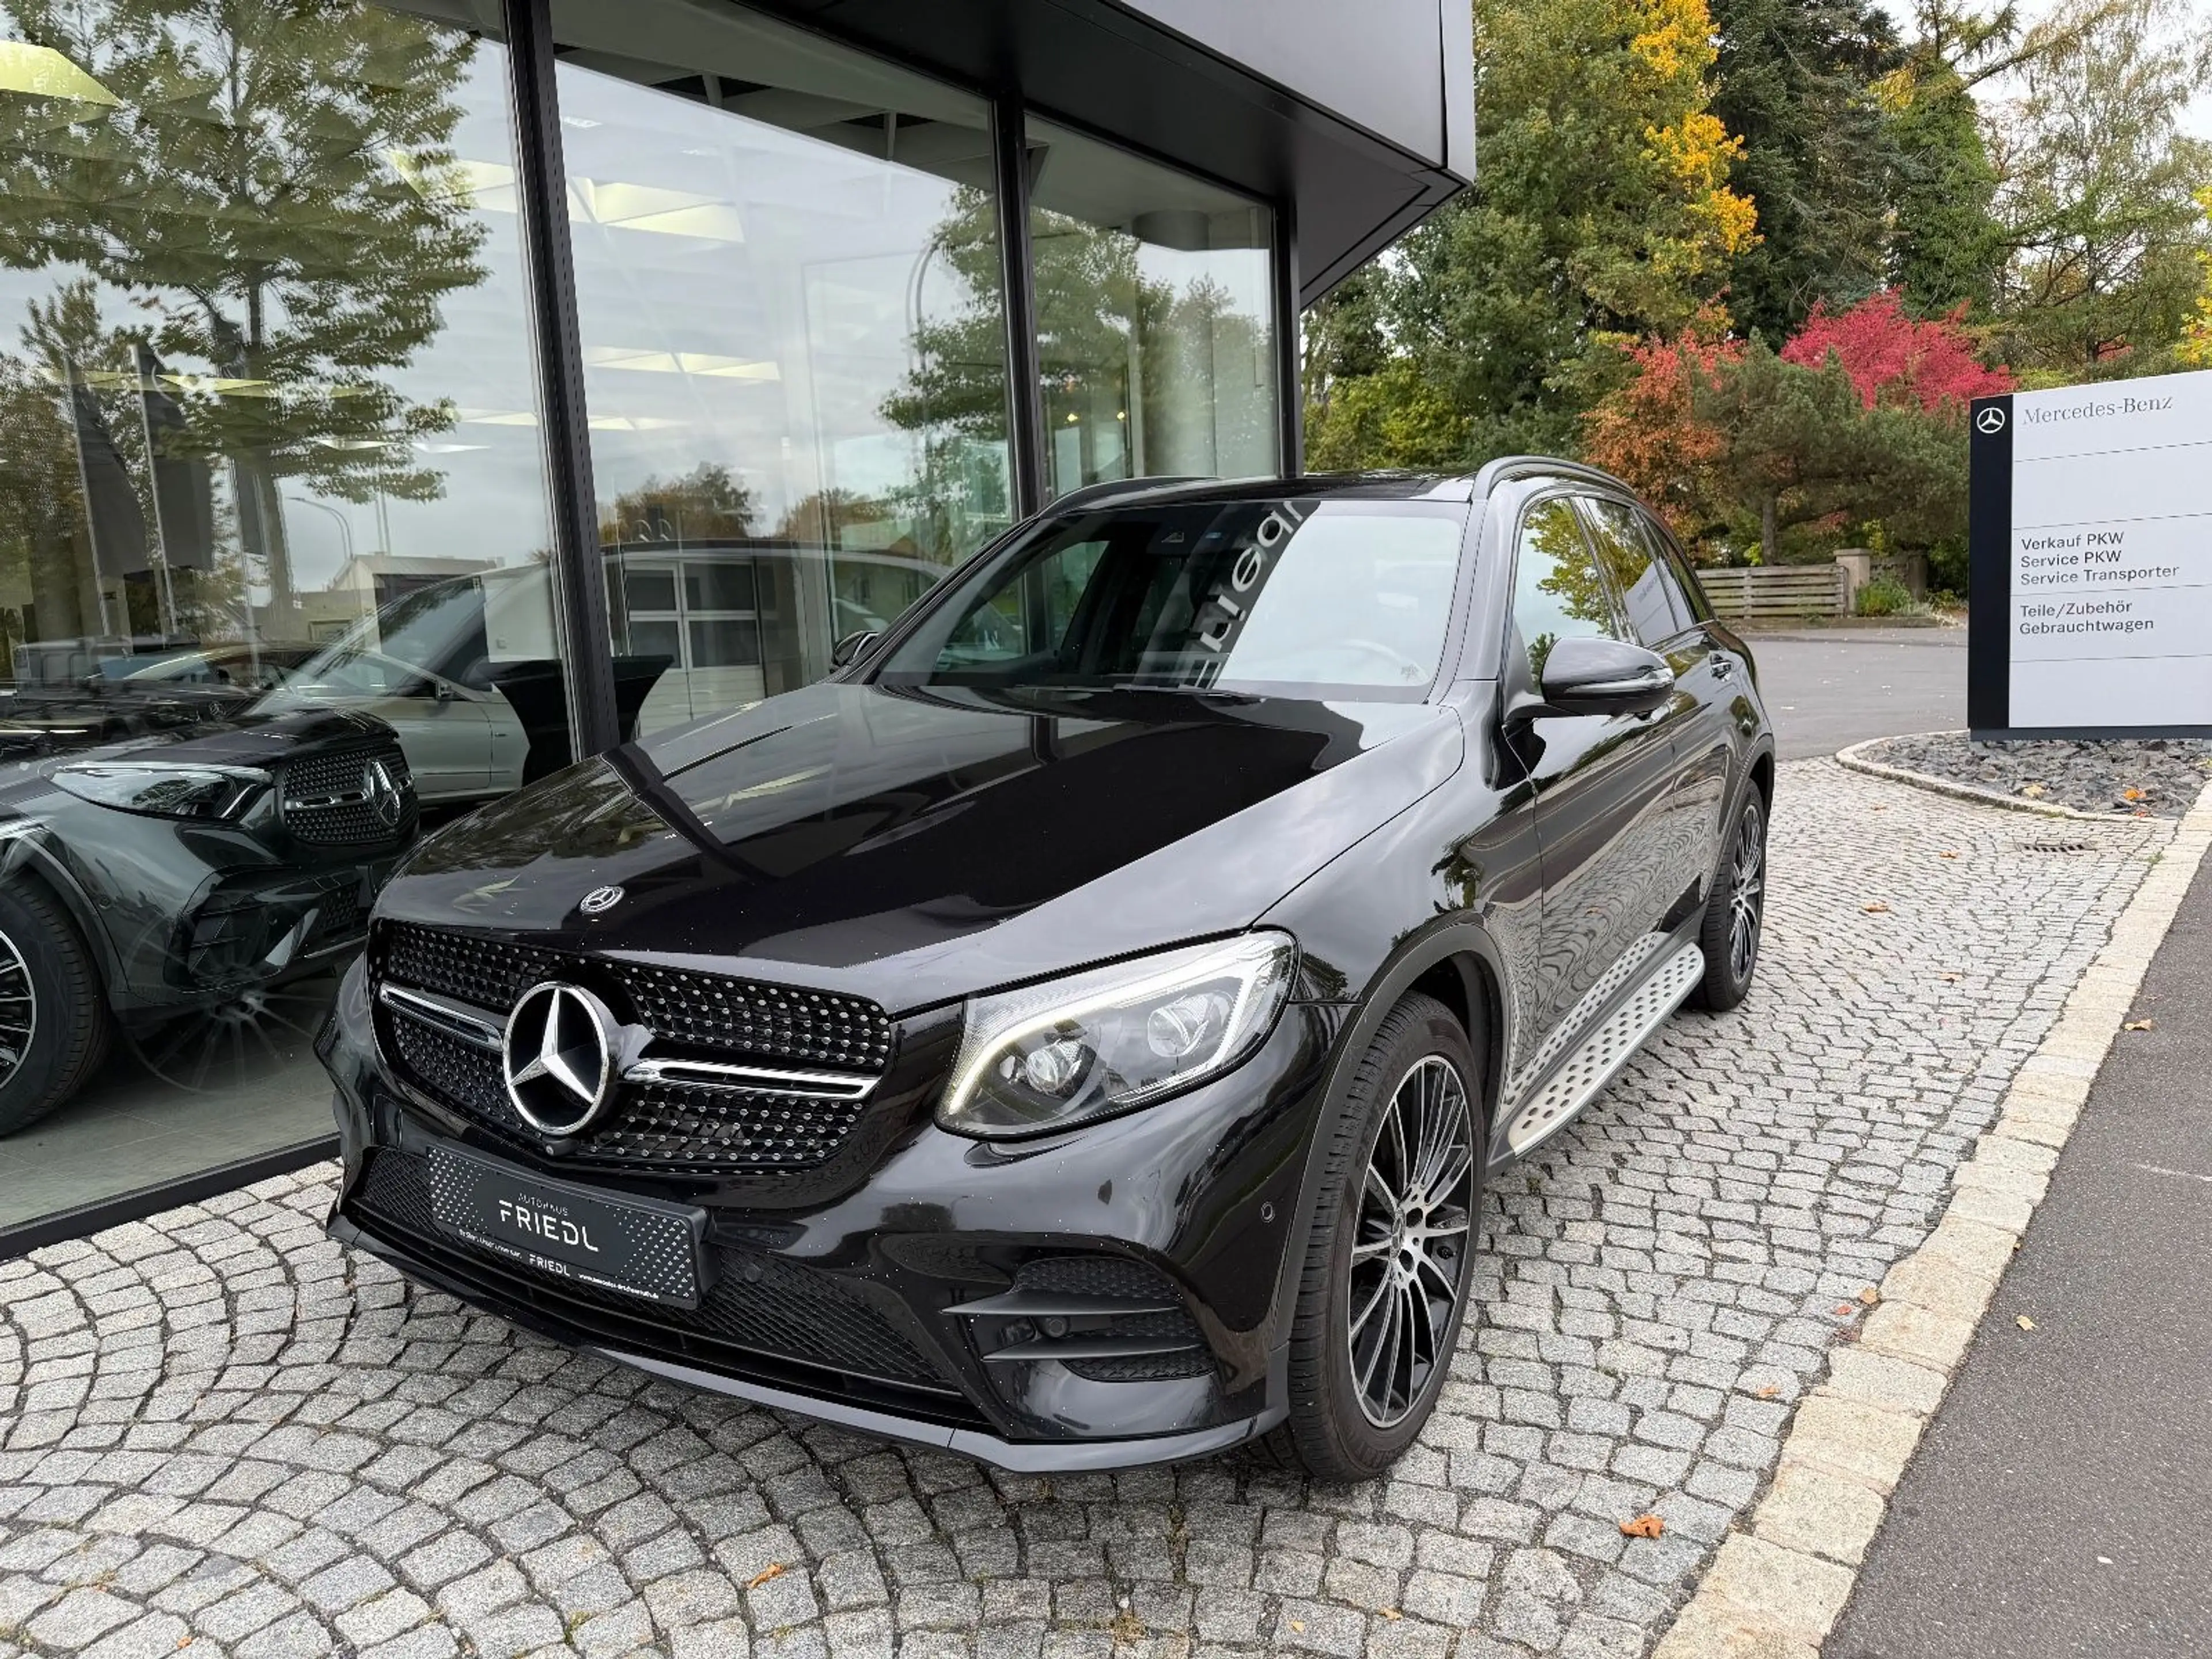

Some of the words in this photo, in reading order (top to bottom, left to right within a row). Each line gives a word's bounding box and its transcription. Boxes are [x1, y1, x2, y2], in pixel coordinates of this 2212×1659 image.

[2023, 396, 2173, 425] Mercedes-Benz
[2021, 533, 2082, 550] Verkauf
[2087, 531, 2124, 546] PKW
[2021, 554, 2079, 568] Service
[2084, 550, 2122, 564] PKW
[2021, 571, 2078, 586] Service
[2083, 566, 2180, 582] Transporter
[2020, 600, 2133, 619] Teile/Zubehör
[2020, 619, 2154, 635] Gebrauchtwagen
[499, 1199, 599, 1252] FRIEDL
[529, 1253, 570, 1277] FRIEDL
